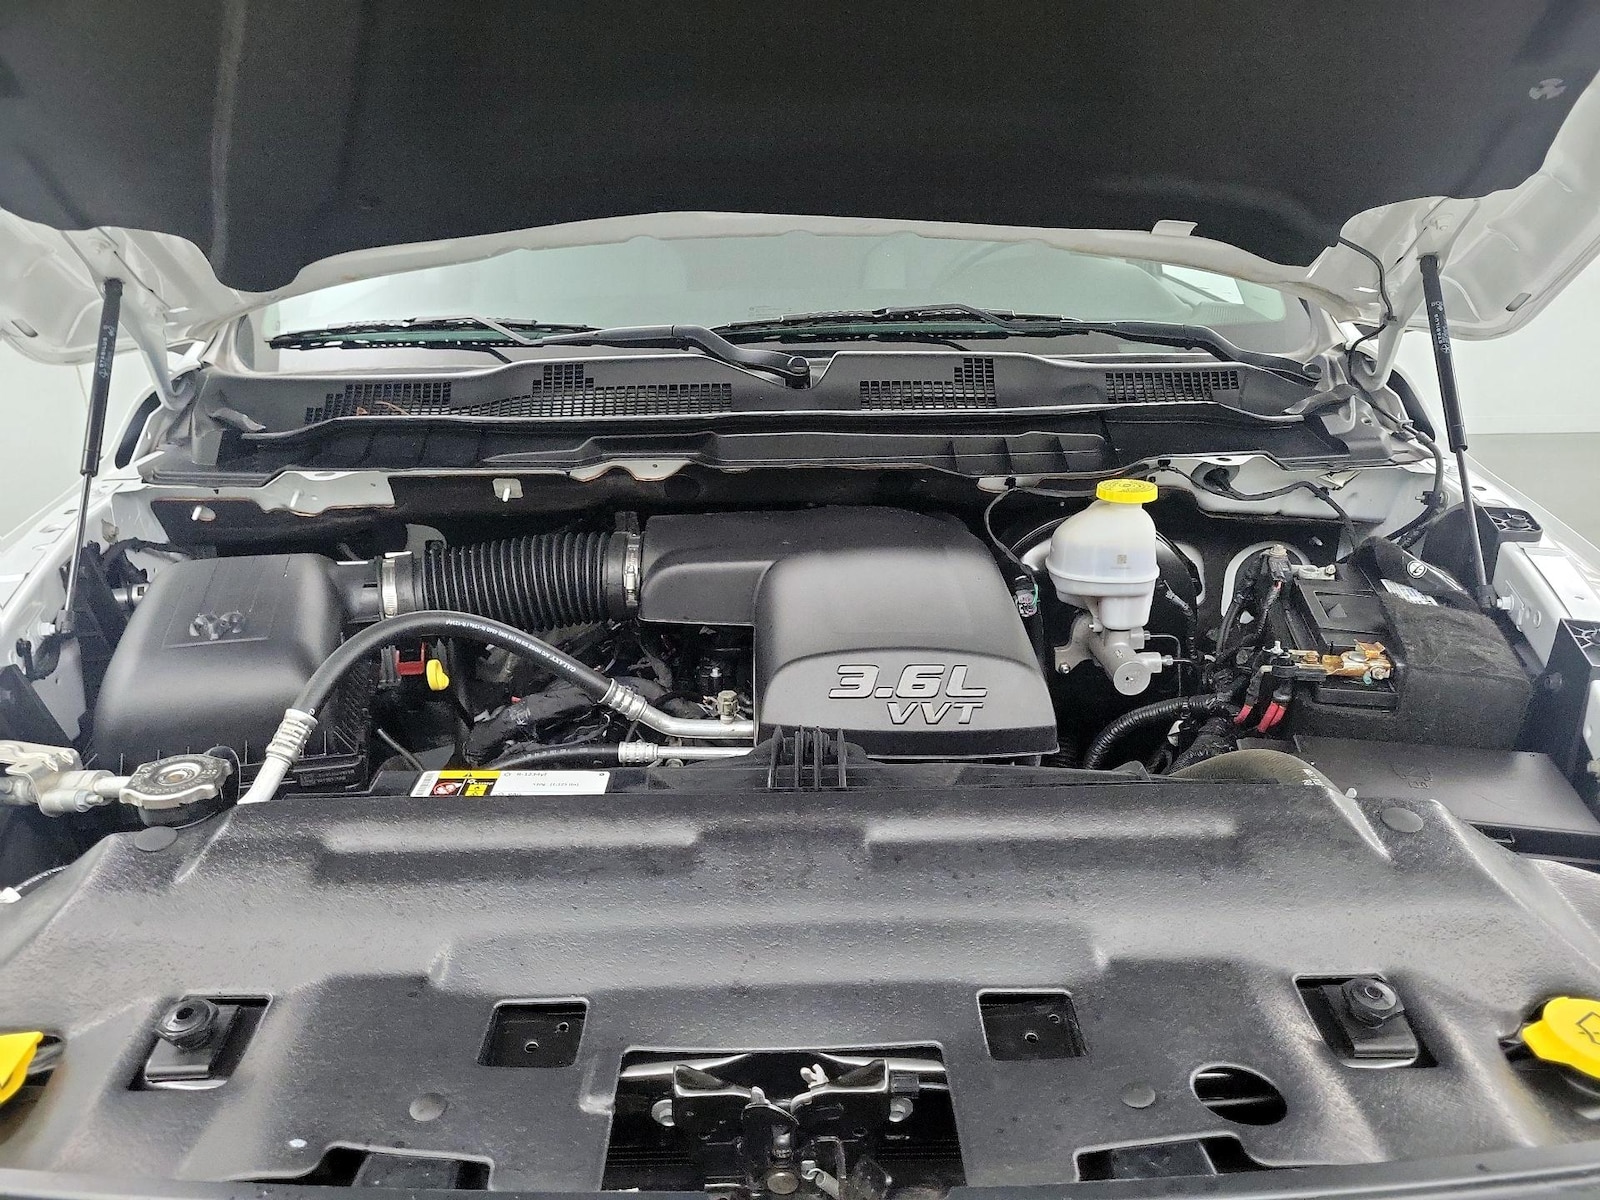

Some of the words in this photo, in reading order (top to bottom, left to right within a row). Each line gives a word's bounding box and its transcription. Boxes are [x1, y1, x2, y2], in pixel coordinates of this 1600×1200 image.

[550, 655, 576, 672] GALAXY
[828, 664, 988, 699] 3.6L
[886, 701, 984, 725] VVT
